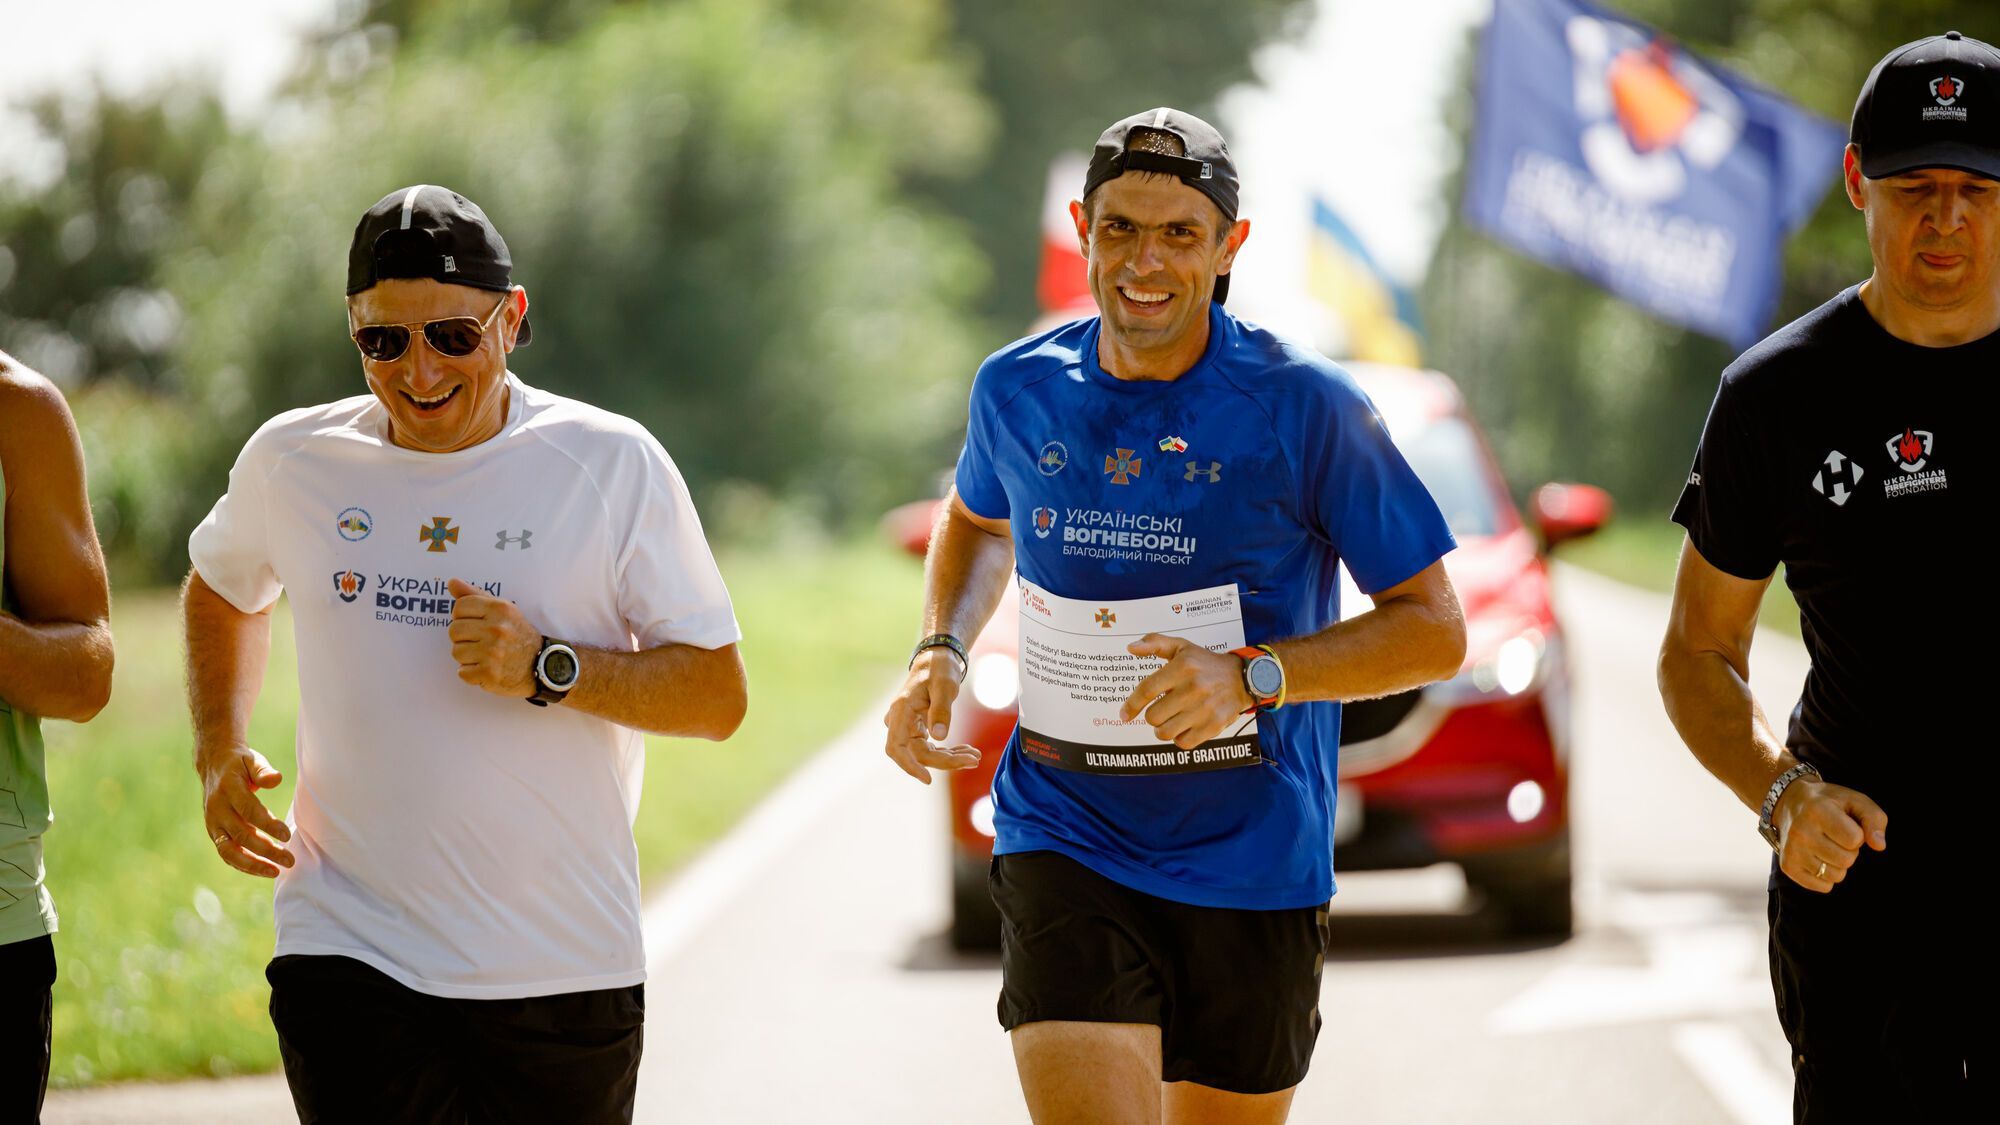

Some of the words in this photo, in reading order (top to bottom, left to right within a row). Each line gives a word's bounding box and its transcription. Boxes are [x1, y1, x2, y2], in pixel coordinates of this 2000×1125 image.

[1884, 469, 1945, 486] UKRAINIAN
[1884, 476, 1947, 492] FIREFIGHTERS
[1886, 482, 1948, 499] FOUNDATION
[1065, 508, 1183, 534] УКРАЇНСЬКІ
[1063, 526, 1196, 554] ВОГНЕБОРЦІ
[1062, 545, 1142, 561] БЛАГОДІЙНИЙ
[1146, 552, 1192, 565] ПРОЄКТ
[378, 574, 501, 597] УКРАЇНКІ
[376, 592, 457, 615] ВОГНЕ
[1186, 596, 1222, 606] UKRAINIAN
[1186, 600, 1233, 612] FIREFIGHTERS
[1187, 606, 1232, 618] FOUNDATION
[1060, 650, 1087, 660] Bardzo
[1088, 654, 1134, 662] wdzięczna
[1204, 642, 1228, 651] kom!
[1042, 664, 1080, 680] Mieszkałam
[1092, 674, 1110, 682] nich
[1058, 660, 1098, 671] wdzięczna
[1100, 664, 1138, 672] rodzinie,
[1070, 692, 1098, 702] bardzo
[1094, 685, 1116, 693] pracy
[1118, 684, 1130, 692] do
[1086, 752, 1176, 768] ULTRAMARATHON
[1178, 751, 1190, 765] OF
[1192, 743, 1252, 763] GRATITUDE
